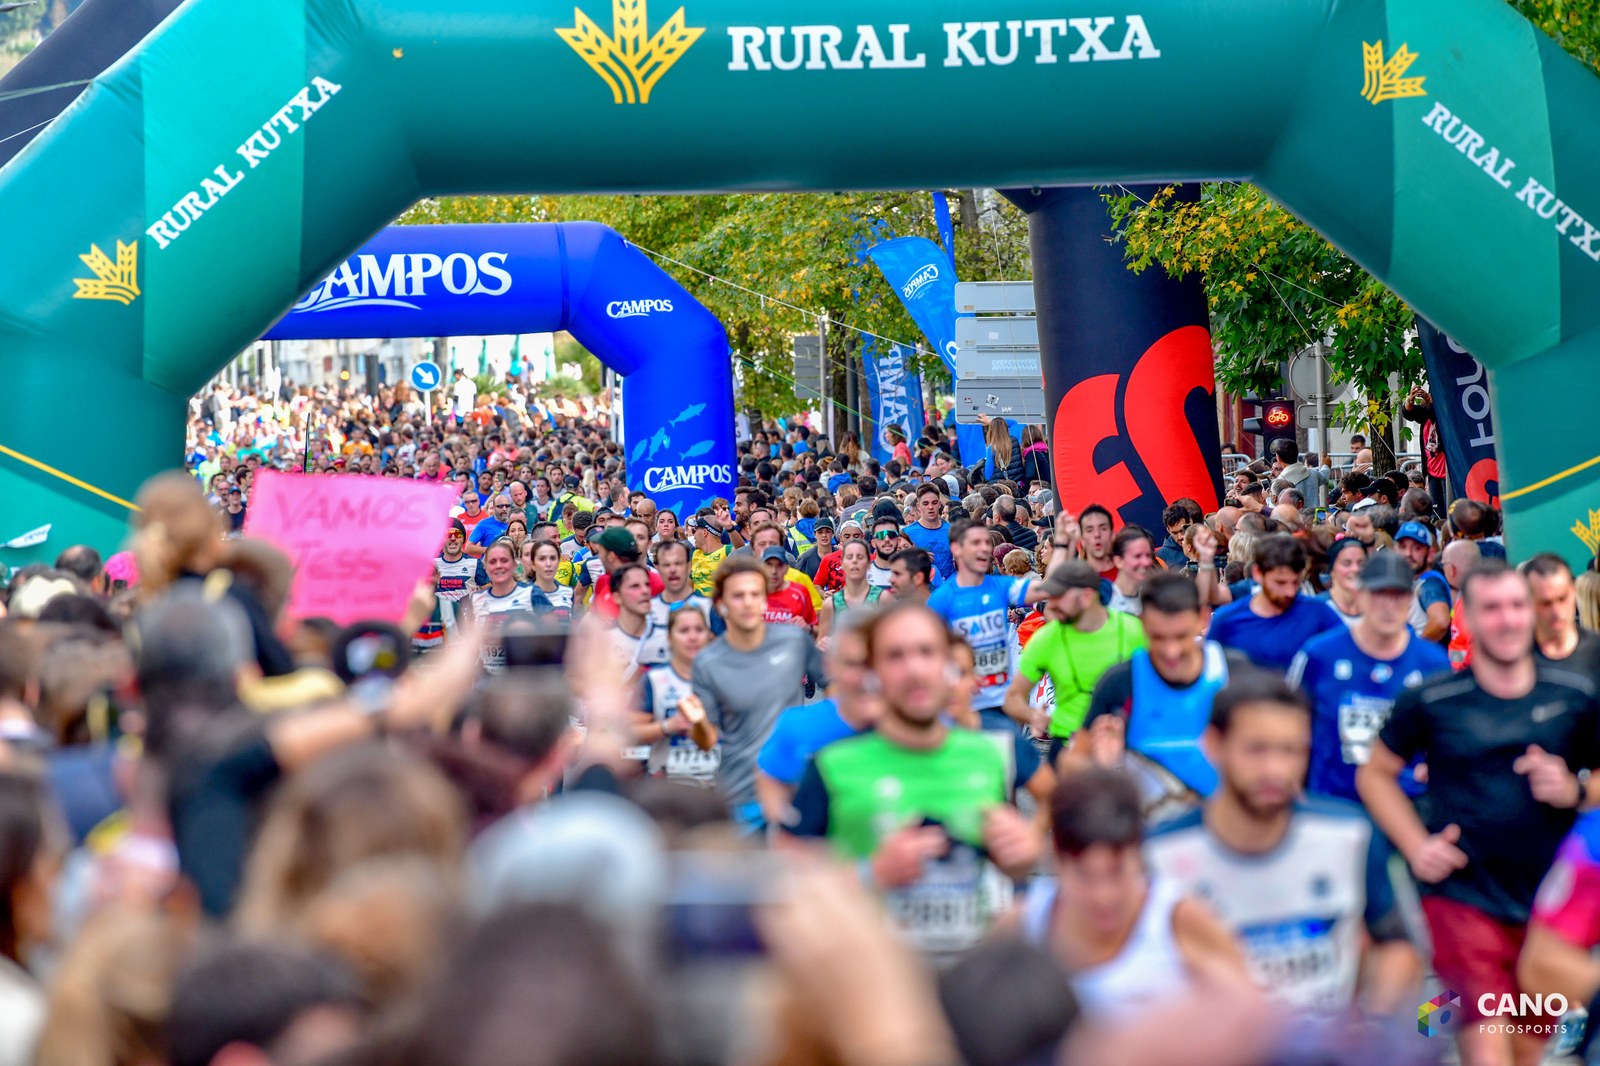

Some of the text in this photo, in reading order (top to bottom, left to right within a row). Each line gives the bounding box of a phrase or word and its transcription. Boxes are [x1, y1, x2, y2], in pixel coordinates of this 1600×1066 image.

[727, 14, 1161, 71] RURAL KUTXA
[145, 76, 342, 249] RURAL KUTXA
[1422, 101, 1600, 262] RURAL KUTX
[605, 298, 673, 317] CAMPOS
[643, 464, 732, 493] CAMPOS
[275, 486, 429, 532] VAMOS
[764, 611, 793, 621] TEAM
[972, 650, 1006, 668] 887
